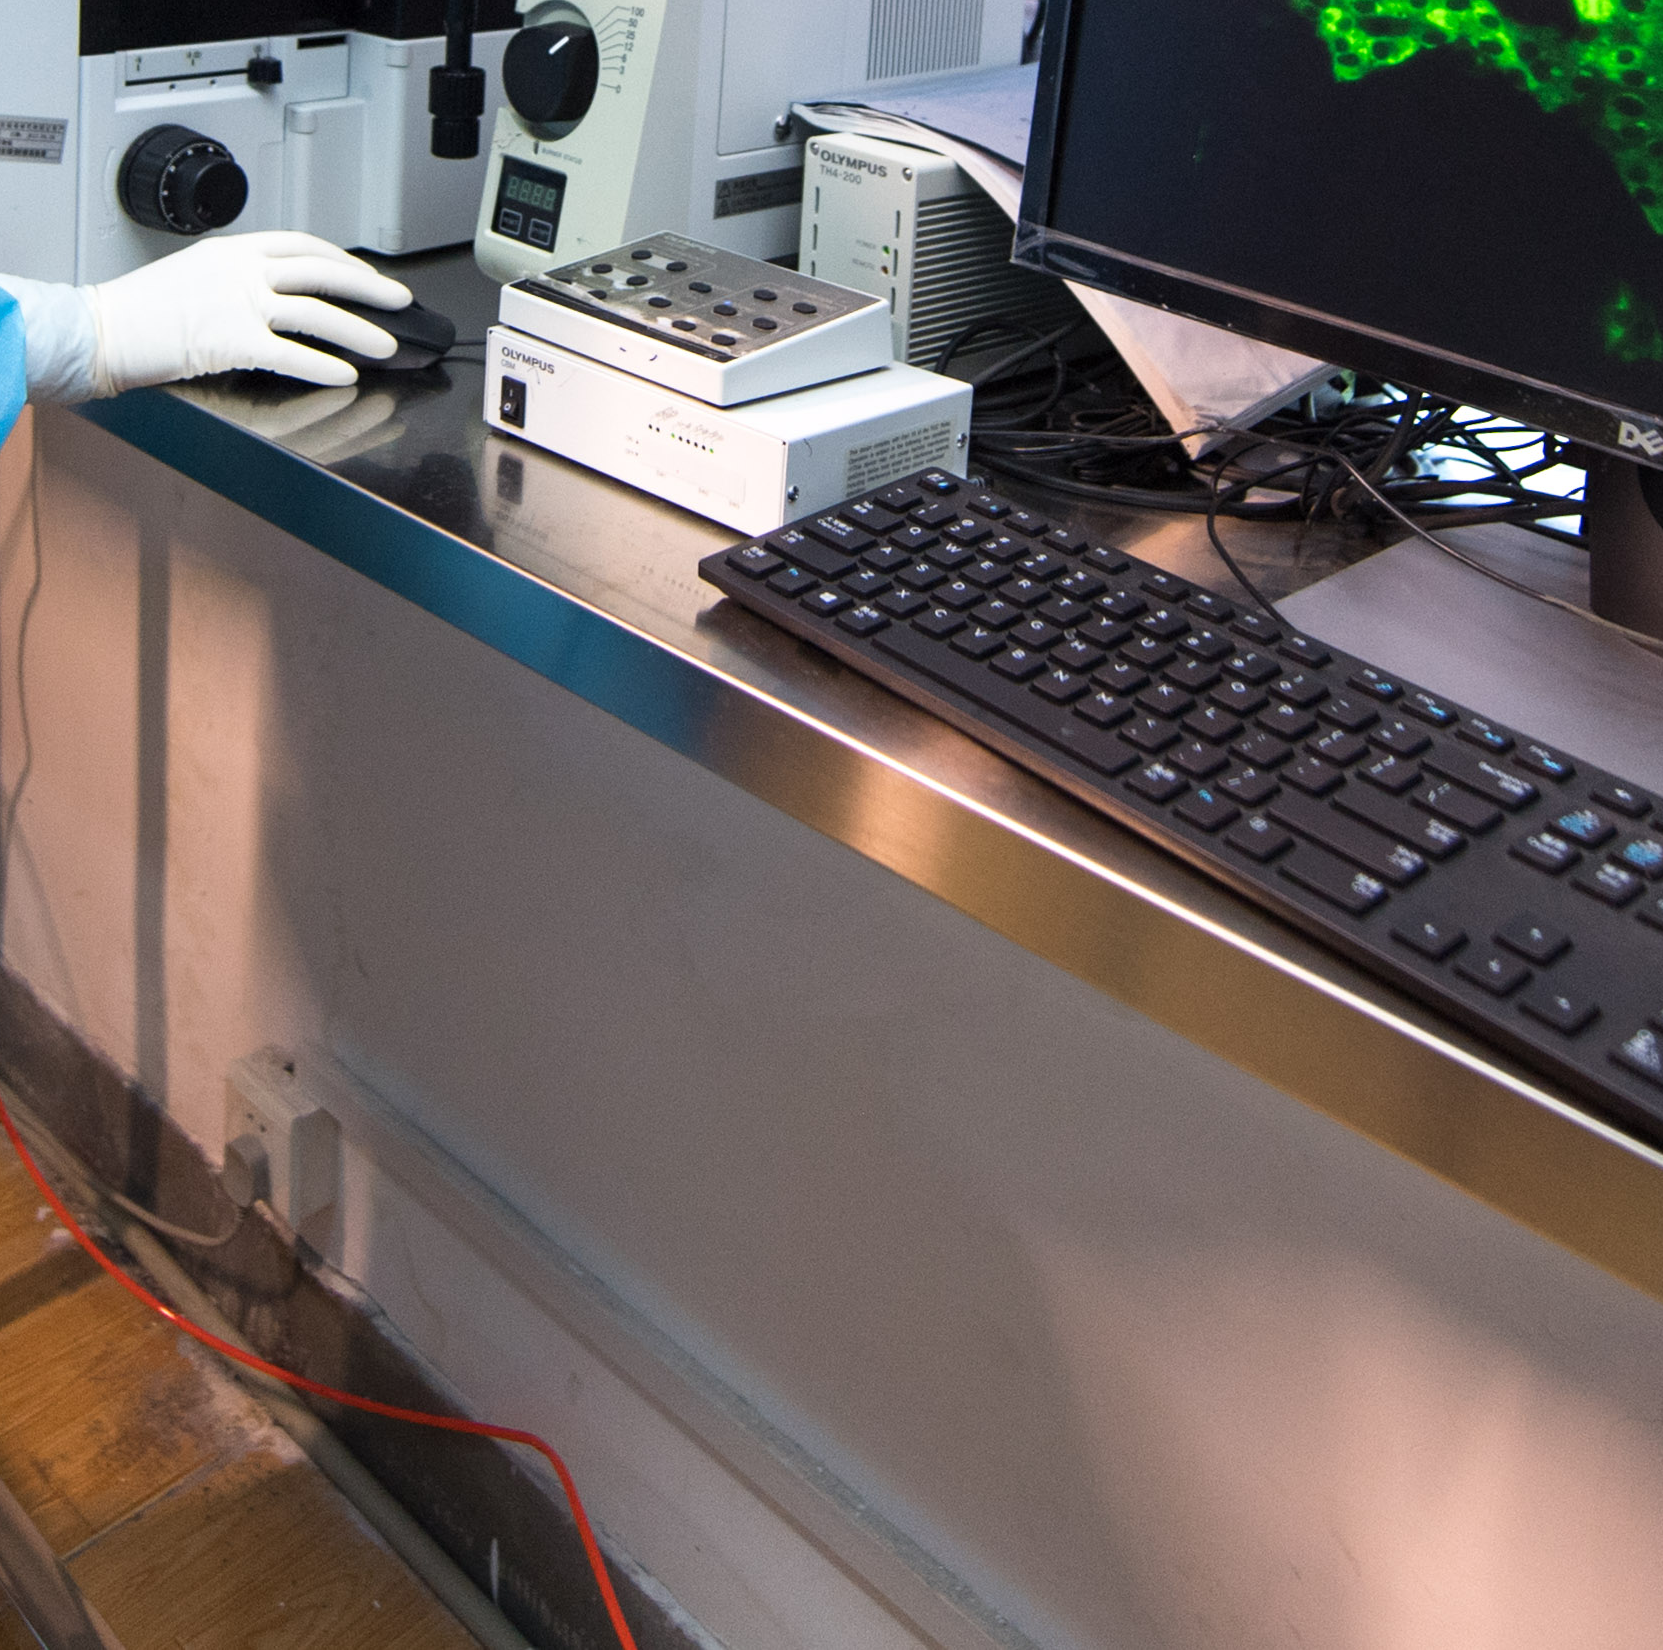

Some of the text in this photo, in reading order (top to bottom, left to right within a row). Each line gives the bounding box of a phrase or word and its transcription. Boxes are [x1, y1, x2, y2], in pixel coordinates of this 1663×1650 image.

[631, 6, 645, 17] 100
[624, 43, 634, 52] 12
[820, 150, 888, 178] OLYMPUS
[820, 165, 862, 185] TH4-200
[502, 346, 555, 374] OLYMPUS
[961, 519, 975, 528] @
[909, 527, 921, 536] Q
[880, 546, 892, 555] A
[946, 543, 962, 554] W
[1036, 554, 1048, 562] $
[916, 564, 929, 573] S
[980, 561, 994, 570] E
[860, 571, 875, 580] Z
[952, 581, 966, 591] D
[1018, 579, 1031, 589] R
[896, 589, 910, 599] X
[991, 600, 1004, 609] F
[1060, 598, 1072, 606] T
[935, 609, 947, 618] C
[1031, 620, 1044, 630] G
[1101, 617, 1113, 627] Y
[975, 628, 987, 638] V
[1070, 640, 1087, 652] H
[1141, 638, 1155, 648] U
[1115, 664, 1128, 672] J
[1053, 670, 1069, 683] N
[1158, 684, 1173, 696] K
[1231, 682, 1246, 693] O
